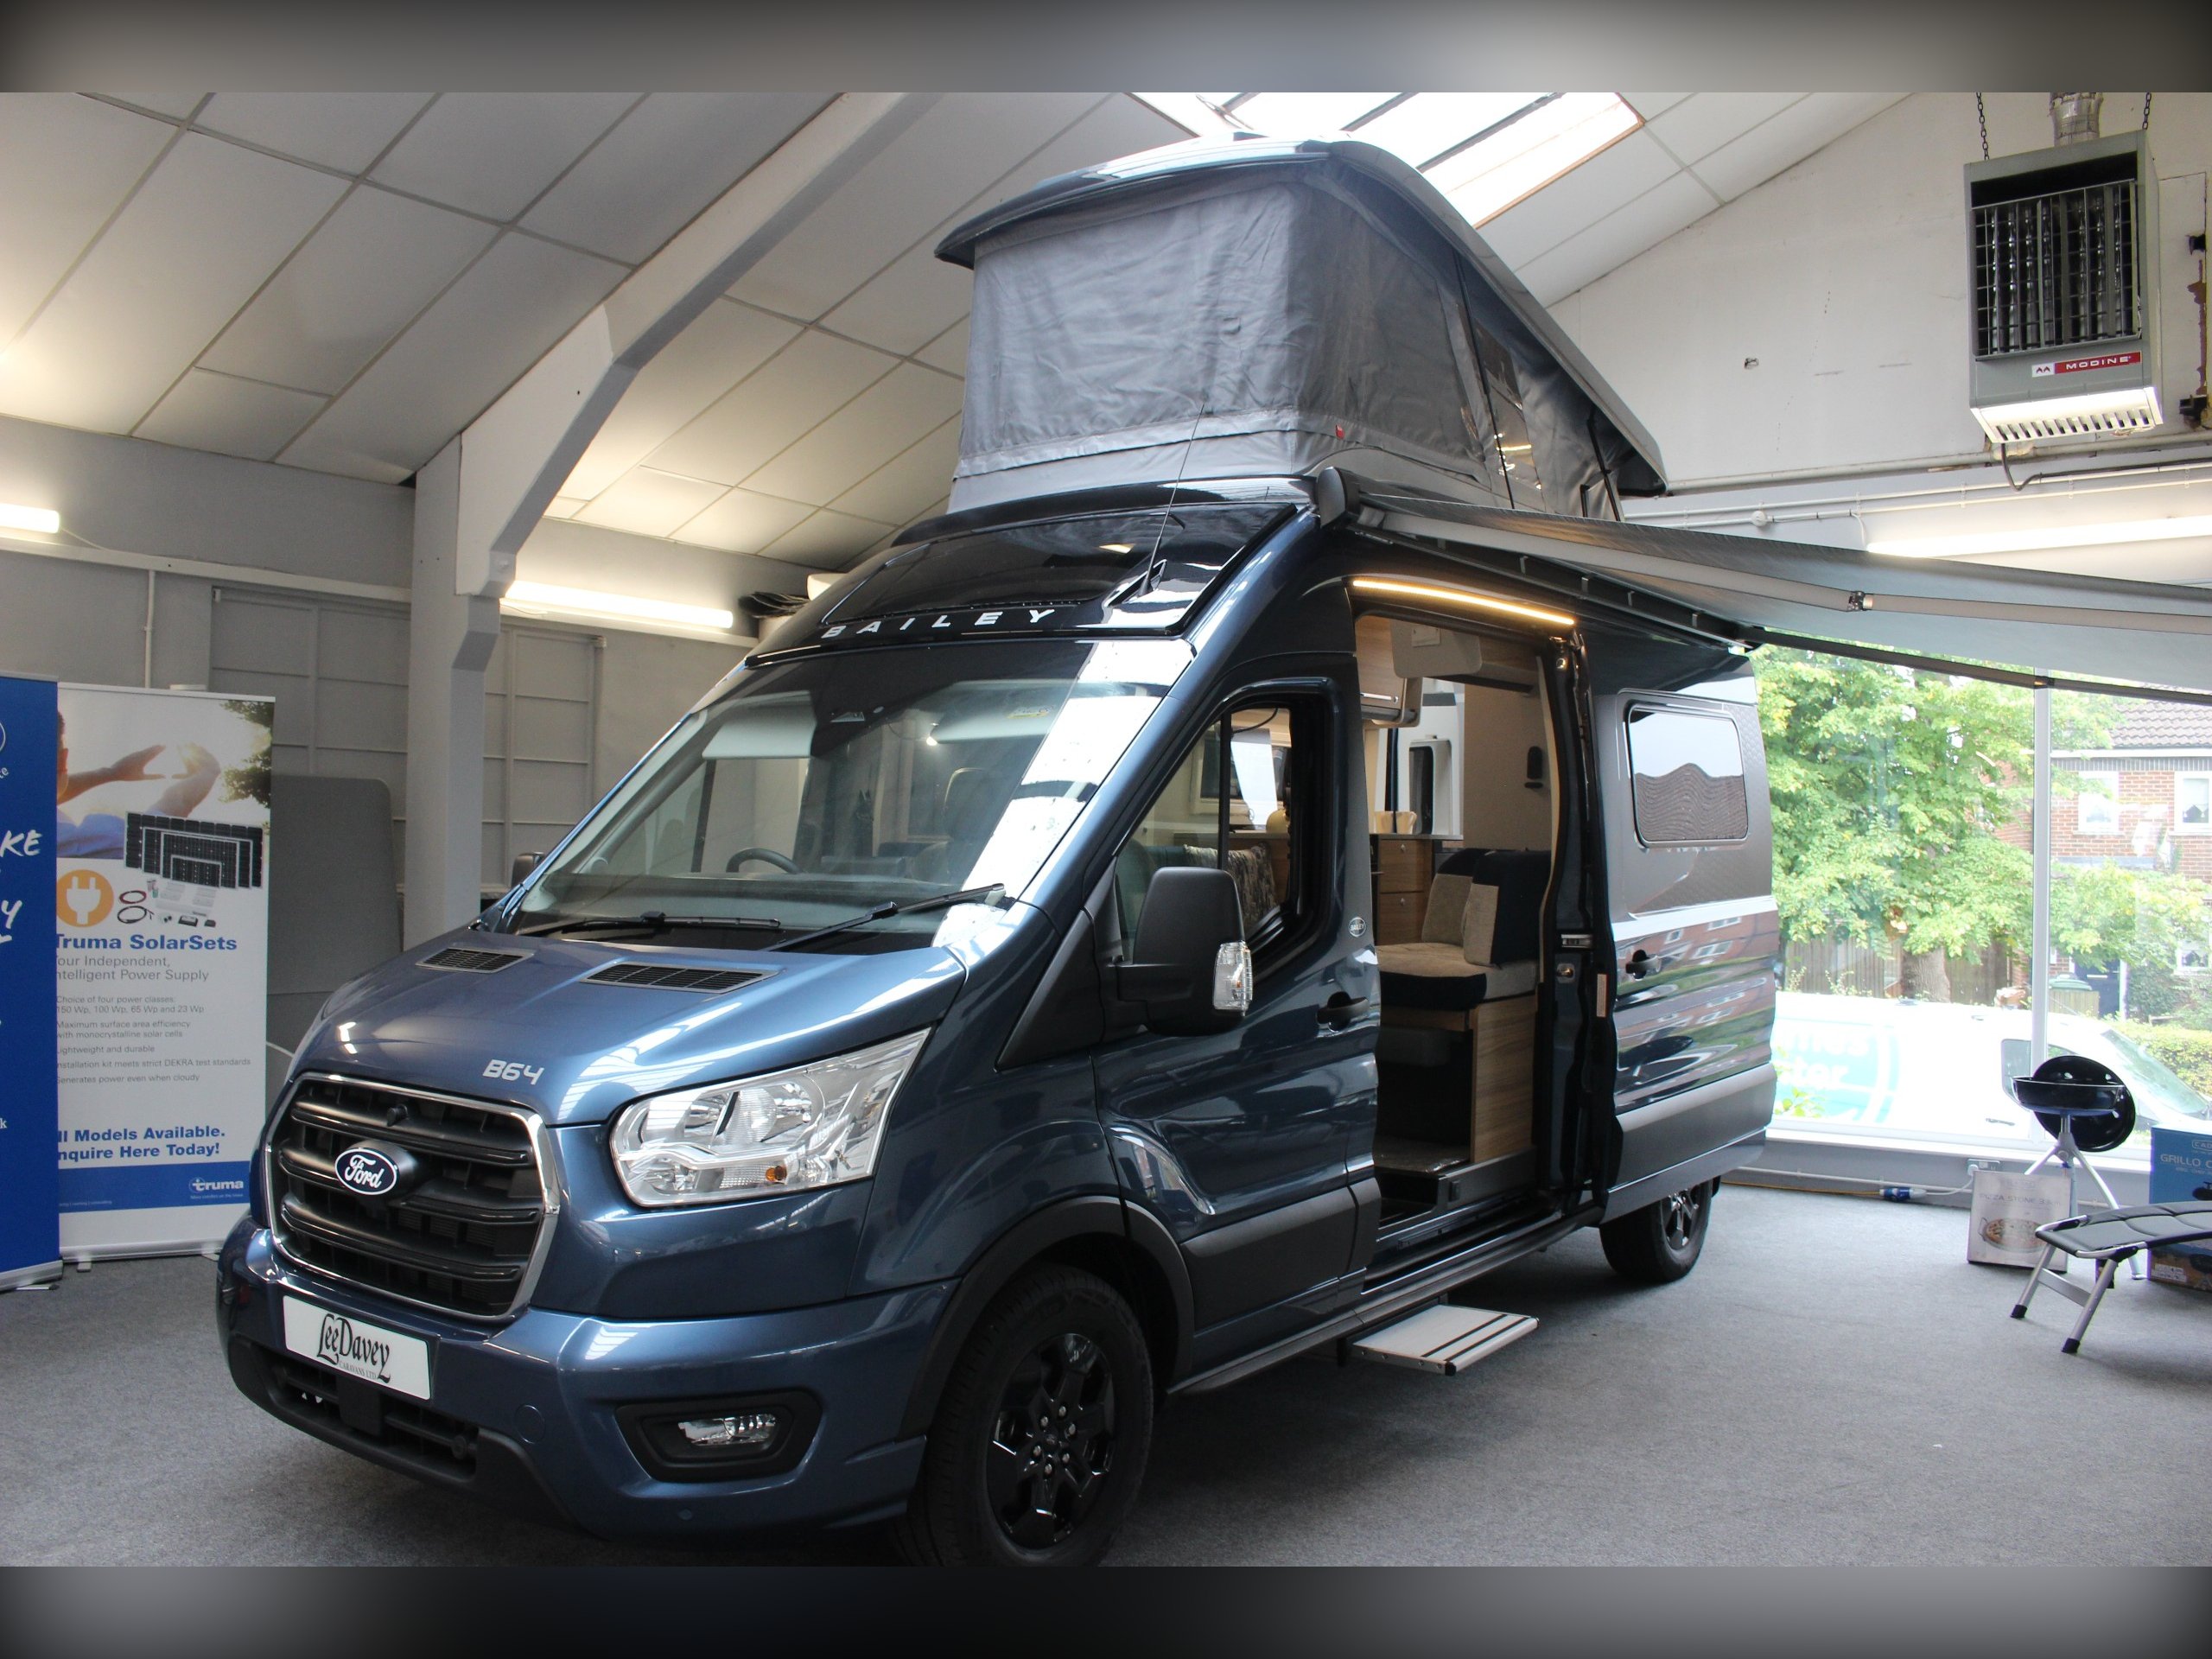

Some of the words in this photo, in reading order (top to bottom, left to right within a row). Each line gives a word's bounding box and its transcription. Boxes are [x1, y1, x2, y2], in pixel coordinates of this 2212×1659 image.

[2065, 356, 2128, 371] MODINE
[821, 608, 1055, 639] BAILEY
[57, 934, 122, 950] Truma
[130, 934, 238, 950] SolarSets
[57, 956, 80, 966] our
[85, 955, 171, 968] Independent,
[57, 969, 116, 982] ntelligent
[120, 969, 161, 981] Power
[165, 969, 209, 982] Supply
[117, 995, 143, 1005] power
[160, 1005, 175, 1014] and
[100, 1020, 130, 1029] surface
[57, 1045, 104, 1055] ightweight
[106, 1045, 122, 1053] and
[57, 1059, 99, 1069] nstallation
[164, 1058, 194, 1067] DEKRA
[213, 1057, 251, 1065] standards
[482, 1058, 545, 1085] B64
[99, 1075, 124, 1084] power
[148, 1074, 171, 1083] when
[58, 1130, 68, 1143] ll
[74, 1128, 138, 1142] Models
[143, 1125, 226, 1140] Available.
[58, 1147, 114, 1162] nquire
[119, 1145, 161, 1159] Here
[166, 1142, 220, 1157] Today!
[2160, 1154, 2201, 1167] GRILLO
[345, 1154, 385, 1188] Ford
[191, 1178, 244, 1192] truma
